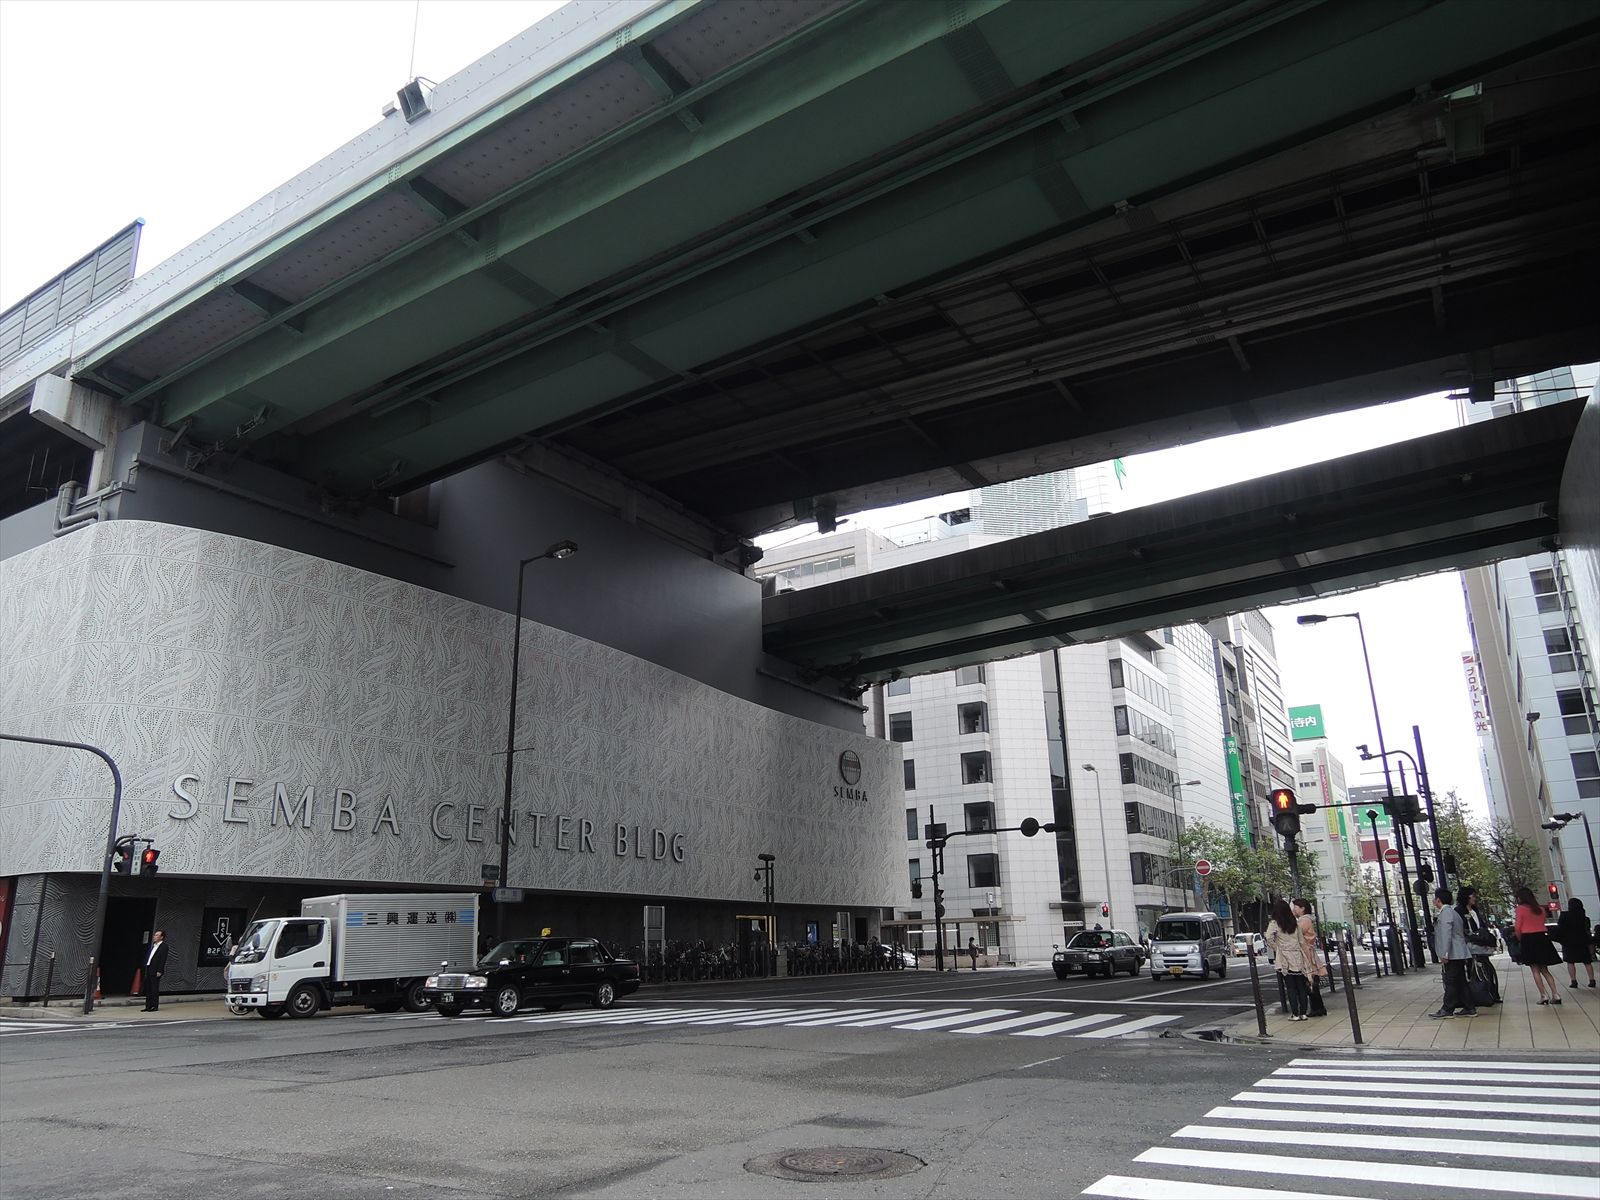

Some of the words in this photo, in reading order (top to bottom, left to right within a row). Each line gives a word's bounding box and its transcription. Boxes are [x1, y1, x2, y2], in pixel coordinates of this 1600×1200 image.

[168, 773, 402, 836] SEMBA
[431, 800, 596, 853] CENTER
[615, 822, 686, 863] BLDG
[833, 786, 868, 802] SEMBA
